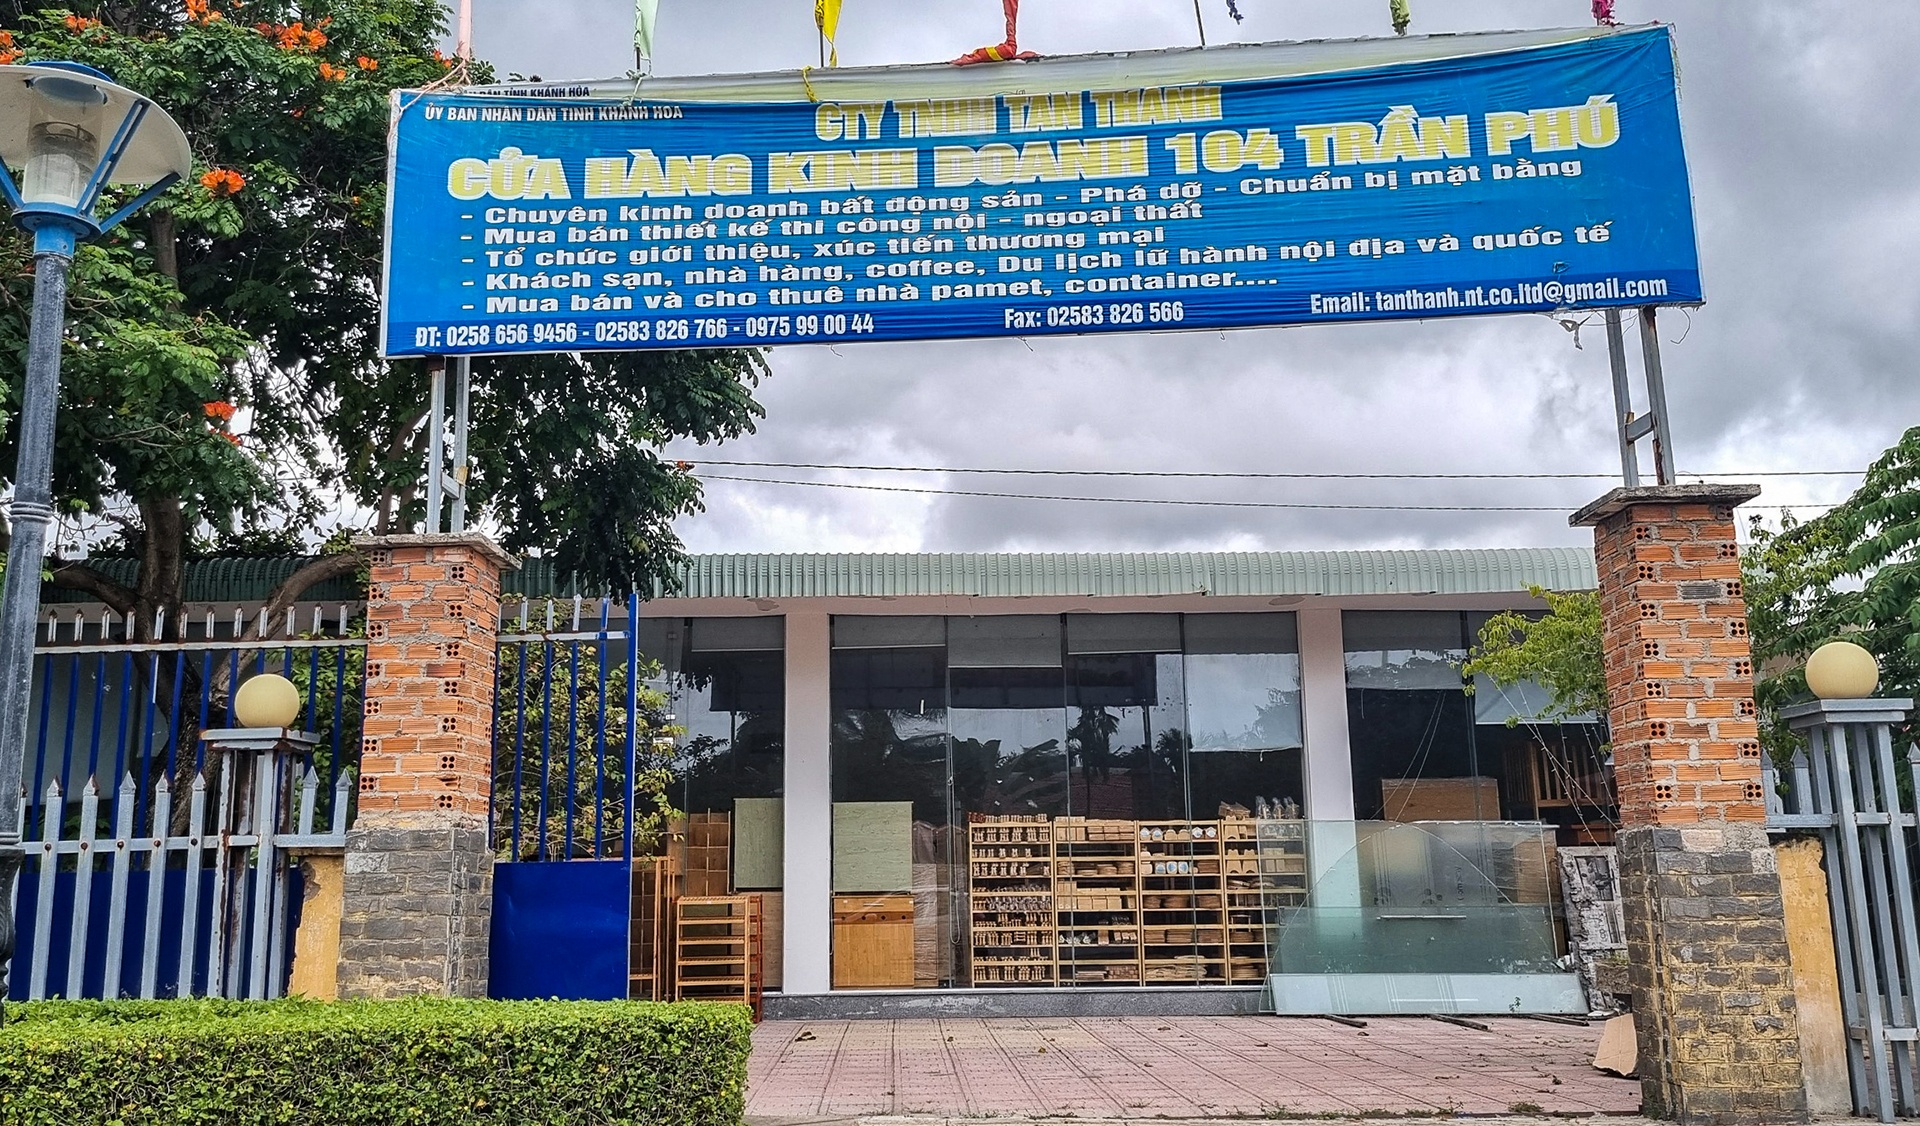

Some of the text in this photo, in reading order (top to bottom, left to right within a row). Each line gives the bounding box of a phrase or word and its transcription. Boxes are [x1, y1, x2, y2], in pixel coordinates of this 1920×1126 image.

[425, 102, 444, 120] ỦY
[448, 107, 477, 121] BAN
[482, 106, 522, 121] NHÂN
[816, 102, 886, 141] CTY
[893, 97, 997, 138] TNHH
[447, 94, 1621, 200] CỬA HÀNG KINH DOANH 104 TRẦN PHÚ
[484, 206, 608, 225] Chuyên
[619, 204, 693, 222] kinh
[704, 200, 809, 219] doanh
[820, 195, 874, 216] bất
[884, 196, 970, 215] động
[981, 190, 1043, 209] sản
[1080, 184, 1147, 203] Phá
[1240, 170, 1352, 195] Chuẩn
[1364, 170, 1398, 190] bị
[1411, 164, 1481, 186] mặt
[1492, 158, 1582, 180] bằng
[484, 228, 556, 245] Mua
[568, 226, 629, 243] bán
[640, 220, 718, 241] thiết
[728, 218, 775, 238] kế
[780, 220, 825, 236] thi
[836, 218, 922, 234] công
[933, 213, 987, 233] nội
[1024, 206, 1121, 227] ngoại
[1134, 200, 1203, 221] thất
[484, 246, 527, 268] Tổ
[535, 247, 617, 266] chức
[628, 245, 693, 265] giới
[703, 242, 801, 263] thiệu,
[813, 239, 876, 258] xúc
[887, 233, 954, 255] tiến
[965, 231, 1086, 251] thương
[1098, 226, 1165, 247] mại
[486, 271, 592, 290] Khách
[602, 270, 673, 290] sạn,
[684, 266, 747, 285] nhà
[758, 264, 854, 282] hàng,
[866, 259, 986, 279] coffee,
[998, 256, 1043, 273] Du
[1055, 251, 1122, 273] lịch
[1180, 244, 1268, 265] hành
[1280, 240, 1336, 262] nội
[1348, 238, 1405, 259] địa
[1417, 233, 1460, 253] và
[1472, 225, 1563, 251] quốc
[1574, 220, 1616, 244] tế
[486, 296, 559, 314] Mua
[570, 293, 632, 312] bán
[644, 292, 683, 310] và
[694, 290, 758, 308] cho
[768, 286, 844, 306] thuê
[856, 283, 920, 303] nhà
[932, 277, 1053, 302] pamet,
[1004, 301, 1185, 329] Fax: 02583 826 566
[1311, 278, 1668, 314] Email: tanthanh.nt.co.ltd@gmail.com
[416, 329, 441, 348] ĐT:
[446, 326, 490, 346] 0258
[495, 325, 529, 344] 656
[534, 323, 578, 343] 9456
[594, 321, 651, 341] 02583
[655, 319, 689, 339] 826
[694, 318, 728, 338] 766
[746, 316, 790, 337] 0975
[796, 315, 819, 335] 99
[824, 314, 846, 335] 00
[851, 313, 875, 333] 44
